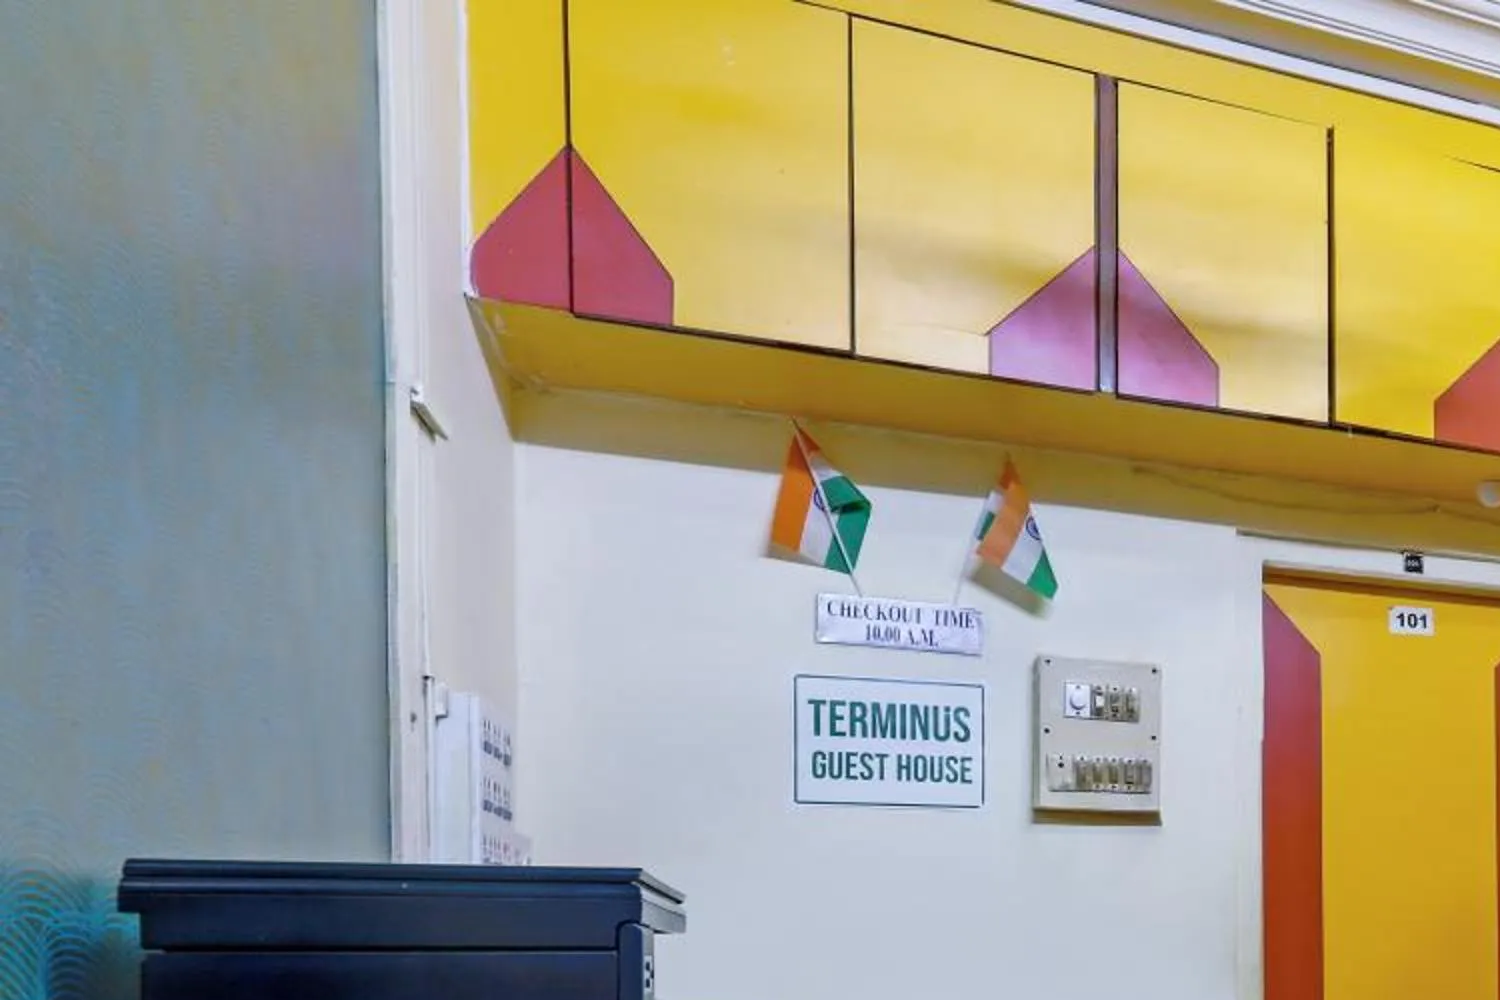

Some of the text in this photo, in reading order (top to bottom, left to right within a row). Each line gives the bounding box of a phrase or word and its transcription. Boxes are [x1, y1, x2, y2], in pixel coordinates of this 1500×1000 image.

[827, 601, 975, 629] CHECKOUT TIME
[1396, 612, 1427, 629] 101
[866, 624, 900, 642] 10.00
[808, 699, 971, 742] TERMINUS
[812, 751, 973, 784] GUEST HOUSE
